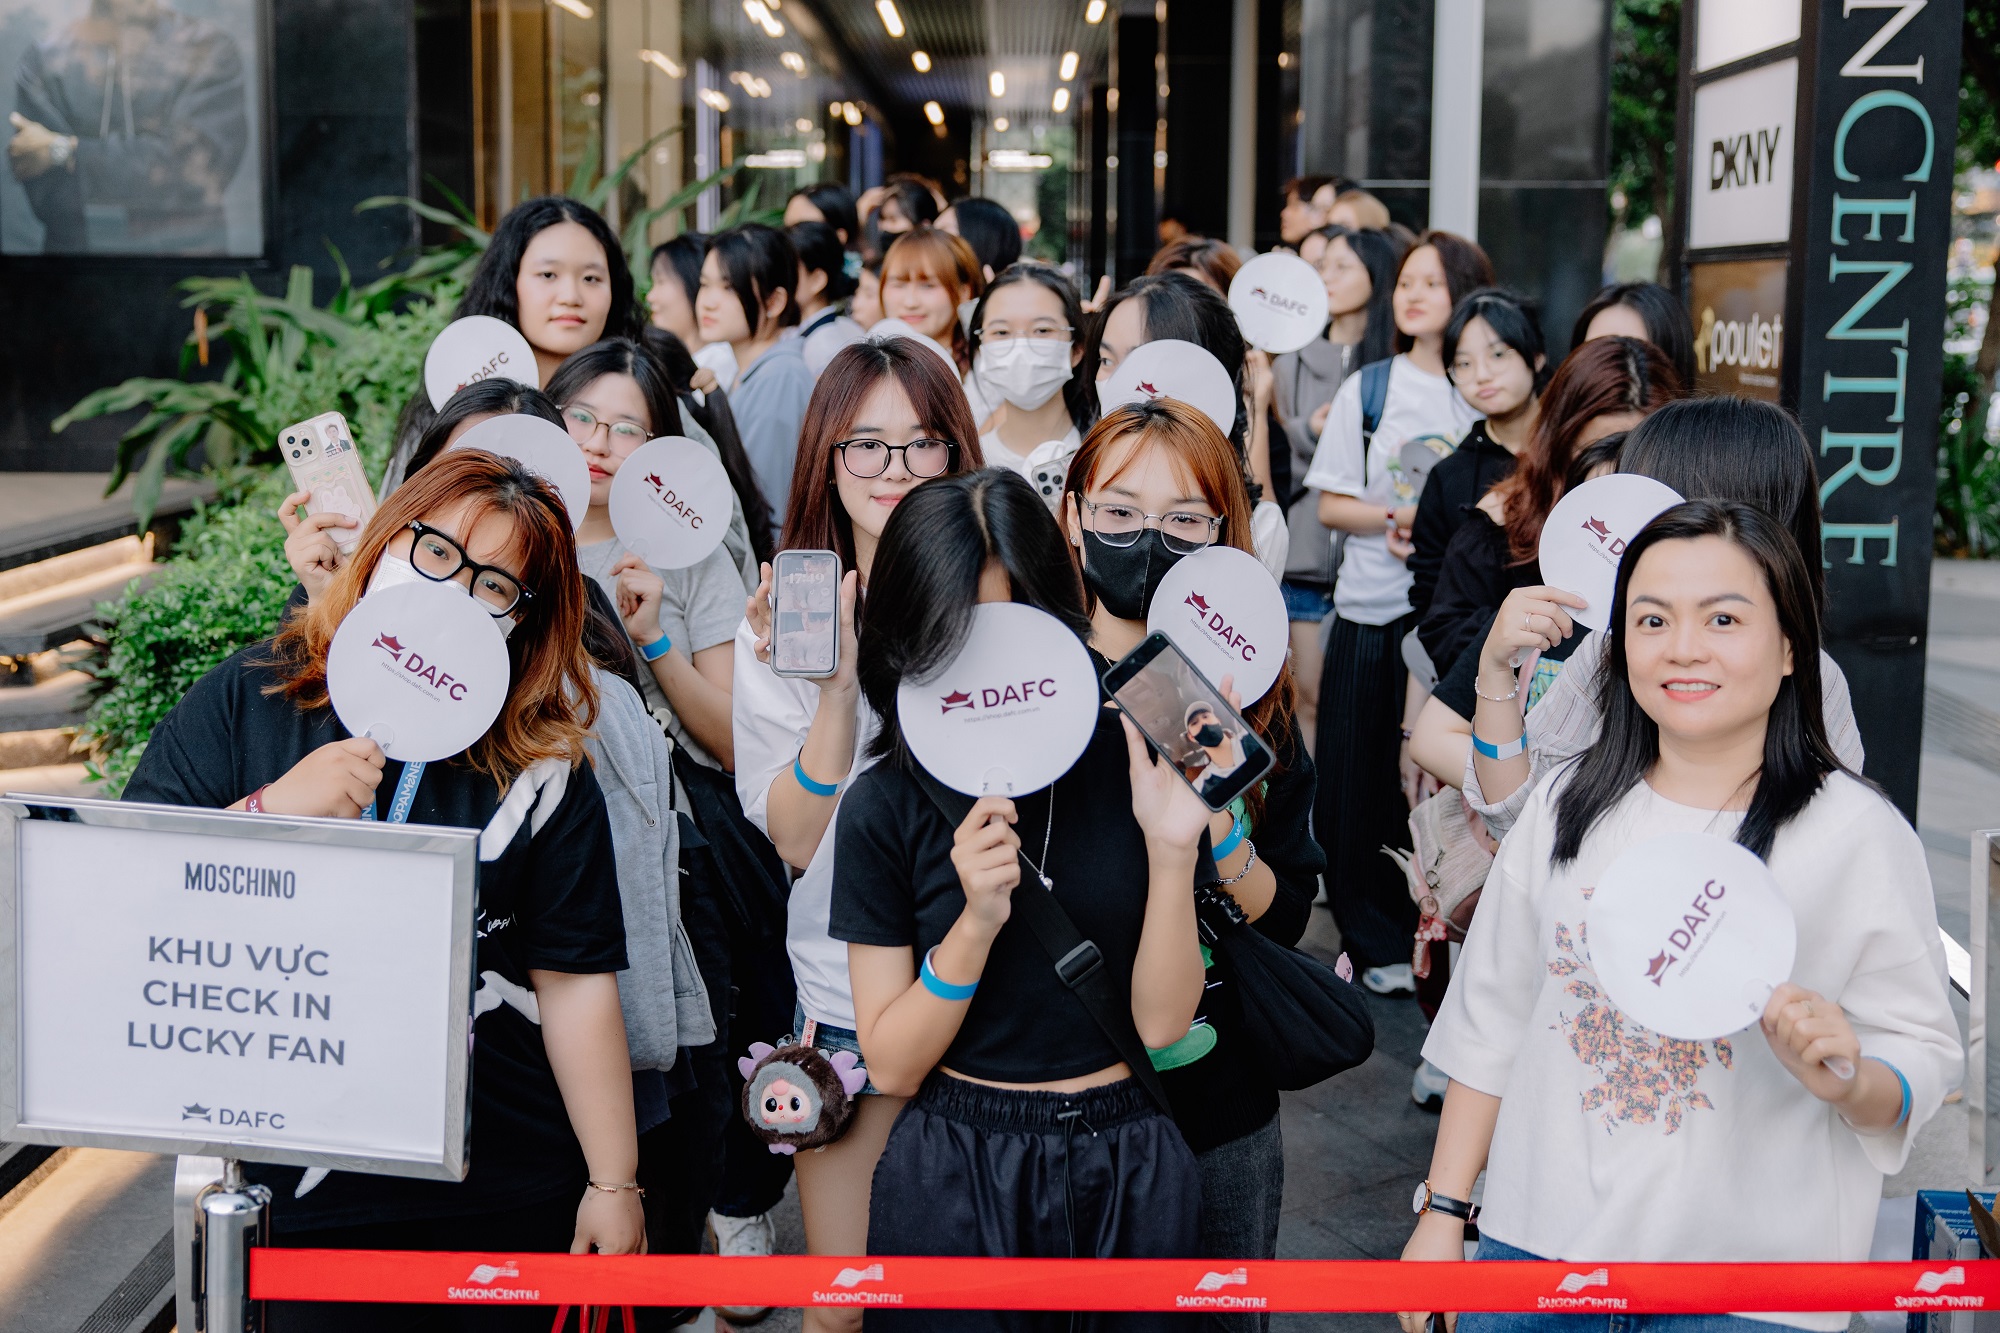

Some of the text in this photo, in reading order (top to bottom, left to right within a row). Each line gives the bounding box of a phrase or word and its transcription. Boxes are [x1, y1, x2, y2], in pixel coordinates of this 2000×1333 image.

[1710, 126, 1781, 190] DKNY
[1269, 293, 1309, 317] DAFC
[1709, 311, 1783, 373] poulet
[471, 351, 509, 383] DAFC
[663, 490, 704, 530] DAFC
[1207, 612, 1256, 662] DAFC
[381, 661, 441, 703] https://shop.dafc.com.vn
[404, 652, 468, 701] DAFC
[982, 678, 1057, 708] DAFC
[184, 861, 296, 899] MOSCHINO
[1668, 879, 1726, 952] DAFC
[148, 935, 330, 981] KHU VỰC
[142, 979, 331, 1021] CHECK IN
[127, 1021, 345, 1066] LUCKY FAN
[219, 1108, 285, 1130] DAFC
